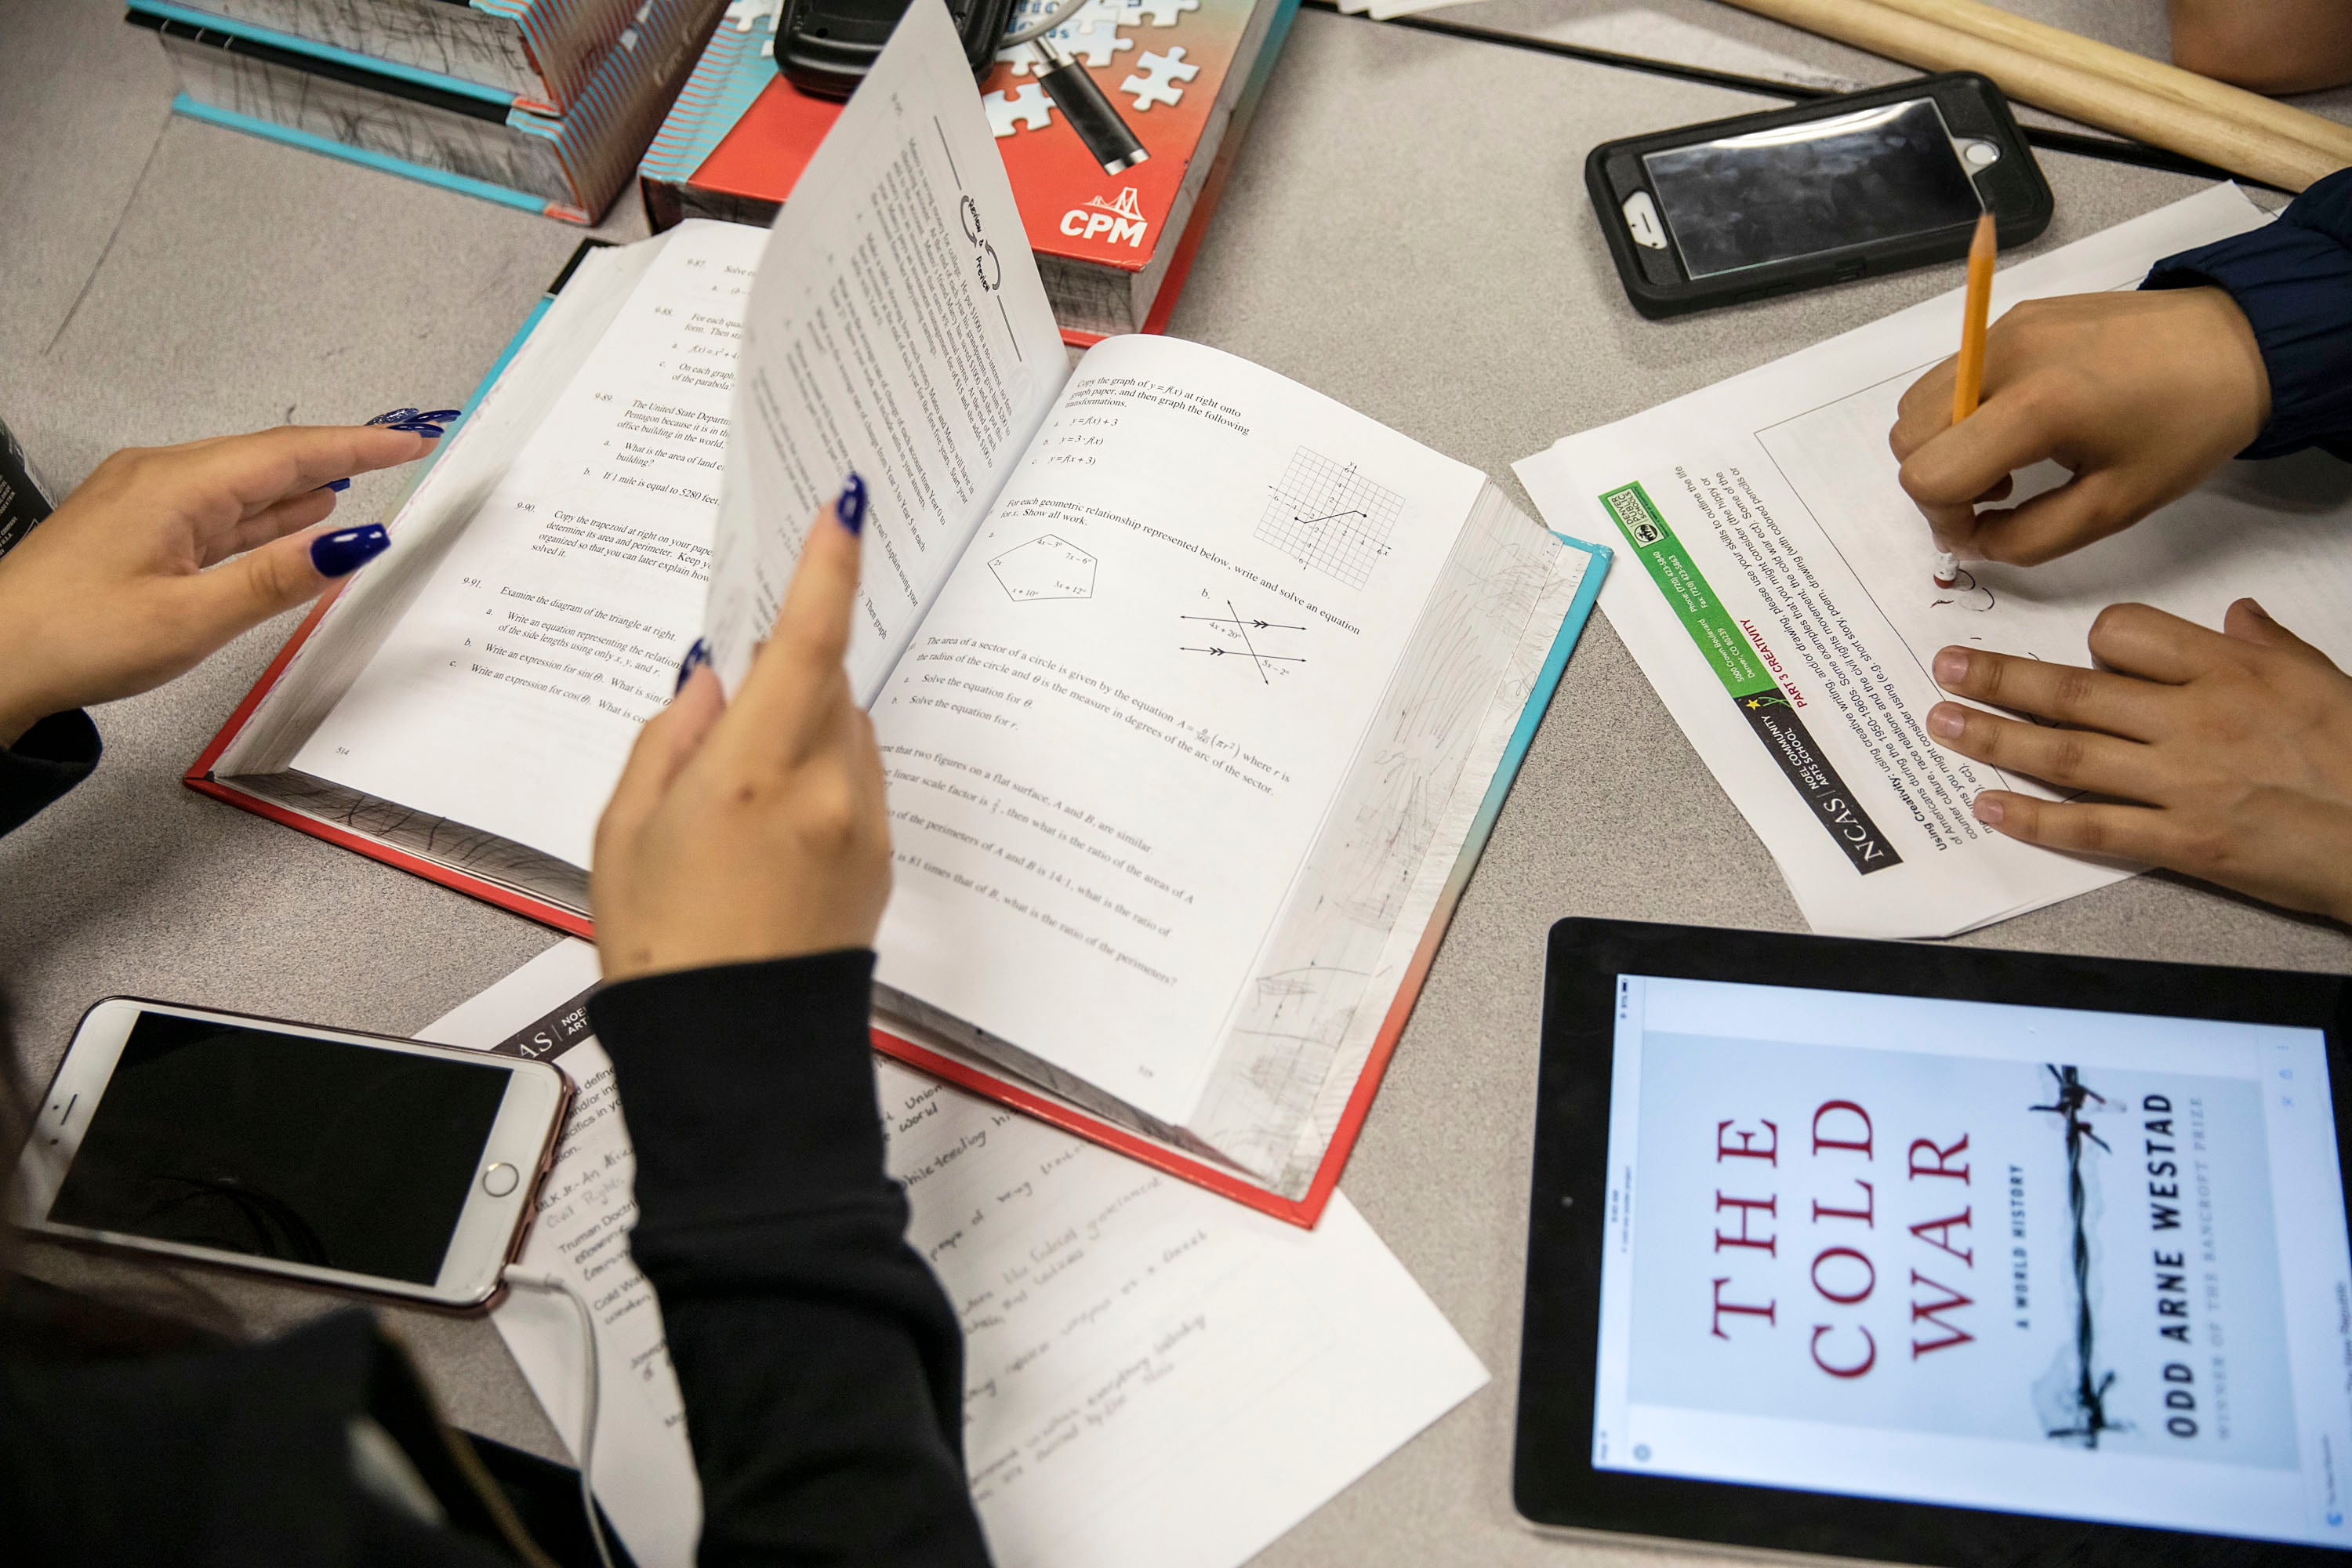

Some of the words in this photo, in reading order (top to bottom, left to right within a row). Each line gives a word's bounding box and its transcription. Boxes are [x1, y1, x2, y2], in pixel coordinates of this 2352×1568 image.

[968, 198, 982, 233] Review
[1060, 209, 1148, 248] CPM
[976, 256, 990, 292] Preview
[1137, 391, 1157, 401] then
[1157, 397, 1185, 410] graph
[1187, 405, 1203, 416] the
[1204, 411, 1250, 436] following
[616, 421, 641, 431] office
[641, 424, 674, 438] building
[673, 431, 684, 440] in
[684, 434, 698, 442] the
[699, 437, 724, 449] world.
[615, 452, 655, 467] building?
[1675, 466, 1687, 479] life
[583, 467, 590, 476] b.
[602, 471, 614, 480] If
[618, 477, 637, 485] mile
[646, 483, 670, 492] equal
[679, 488, 702, 499] 5280
[1684, 479, 1697, 492] the
[1700, 477, 1711, 486] or
[1715, 471, 1729, 486] the
[1722, 486, 1735, 495] of
[1611, 496, 1634, 525] DENVER
[1617, 494, 1642, 522] PUBLIC
[1624, 491, 1647, 519] SCHOOLS
[1693, 493, 1715, 519] outline
[1707, 488, 1727, 510] hippy
[1732, 495, 1752, 520] Some
[1022, 508, 1045, 517] Show
[1047, 510, 1062, 520] all
[1062, 514, 1087, 526] work.
[1712, 520, 1722, 529] to
[1723, 509, 1740, 526] (the
[1749, 520, 1766, 539] ect).
[1719, 529, 1737, 550] skills
[1734, 528, 1762, 561] consider
[1762, 540, 1777, 556] war
[877, 524, 887, 541] run?
[884, 540, 901, 572] Explain
[898, 570, 911, 593] using
[907, 589, 918, 607] your
[1007, 499, 1020, 508] For
[1020, 497, 1039, 506] each
[1038, 499, 1084, 511] geometric
[1085, 507, 1142, 531] relationship
[1142, 526, 1199, 553] represented
[1200, 547, 1231, 570] below,
[1235, 565, 1258, 582] write
[1260, 579, 1279, 592] and
[1280, 589, 1305, 606] solve
[1306, 603, 1318, 613] an
[1319, 611, 1360, 635] equation
[1652, 551, 1674, 577] 423-5840
[1668, 554, 1690, 581] 423-5863
[1733, 552, 1752, 570] your
[1758, 561, 1780, 586] might
[1771, 555, 1790, 573] cold
[1669, 576, 1686, 593] (720)
[1686, 580, 1701, 597] (720)
[1747, 570, 1762, 586] use
[1787, 574, 1800, 589] the
[1682, 592, 1698, 613] Phone:
[1697, 595, 1709, 609] Fax:
[1759, 586, 1784, 615] please
[1776, 586, 1794, 602] you
[463, 576, 481, 589] 9-91.
[499, 586, 535, 601] Examine
[535, 595, 550, 605] the
[550, 599, 583, 614] diagram
[583, 608, 597, 616] of
[593, 610, 608, 619] the
[608, 614, 642, 630] triangle
[652, 628, 676, 641] right.
[1786, 601, 1803, 619] that
[1797, 588, 1833, 635] movement,
[1697, 619, 1722, 648] Boulevard
[1717, 627, 1734, 646] 80239
[1740, 619, 1783, 673] CREATIVITY
[1779, 615, 1806, 652] drawing,
[1799, 619, 1831, 660] examples
[1719, 647, 1734, 668] Crown
[1730, 645, 1740, 656] CO
[1829, 635, 1851, 659] rights
[1730, 666, 1744, 683] 5000
[1737, 655, 1755, 679] Denver,
[1802, 653, 1827, 678] and/or
[1828, 660, 1850, 687] Some
[1845, 659, 1863, 676] civil
[1783, 682, 1808, 708] PART
[1824, 679, 1849, 712] writing,
[1860, 677, 1874, 692] the
[909, 695, 934, 706] Solve
[935, 699, 950, 709] the
[950, 704, 993, 720] equation
[993, 714, 1011, 727] for
[1868, 692, 1886, 710] and
[1849, 687, 1888, 742] 1950-1960s.
[1761, 715, 1802, 766] COMMUNITY
[1846, 713, 1873, 748] creative
[1883, 712, 1914, 750] relations
[336, 746, 350, 755] 514
[1784, 728, 1813, 764] SCHOOL
[1886, 742, 1900, 758] the
[1869, 748, 1891, 772] using
[1896, 758, 1920, 786] during
[1910, 750, 1928, 771] race
[1798, 766, 1820, 789] NOEL
[1808, 764, 1830, 786] ARTS
[1927, 771, 1952, 805] culture,
[1887, 773, 1926, 822] Creativity:
[1917, 787, 1955, 834] Americans
[1823, 798, 1884, 862] NCAS
[1923, 822, 1947, 851] Using
[1948, 807, 1978, 840] counter
[1949, 836, 1963, 845] of
[568, 1018, 589, 1036] ART
[519, 1032, 553, 1058] AS
[2143, 1094, 2180, 1231] WESTAD
[2009, 1166, 2025, 1238] HISTORY
[558, 1223, 601, 1254] Truman
[1711, 1119, 1777, 1340] THE
[1810, 1099, 1877, 1379] COLD
[1908, 1133, 1974, 1361] WAR
[2013, 1247, 2027, 1308] WORLD
[2154, 1250, 2189, 1344] ARNE
[2016, 1320, 2029, 1329] A
[2163, 1363, 2198, 1439] ODD
